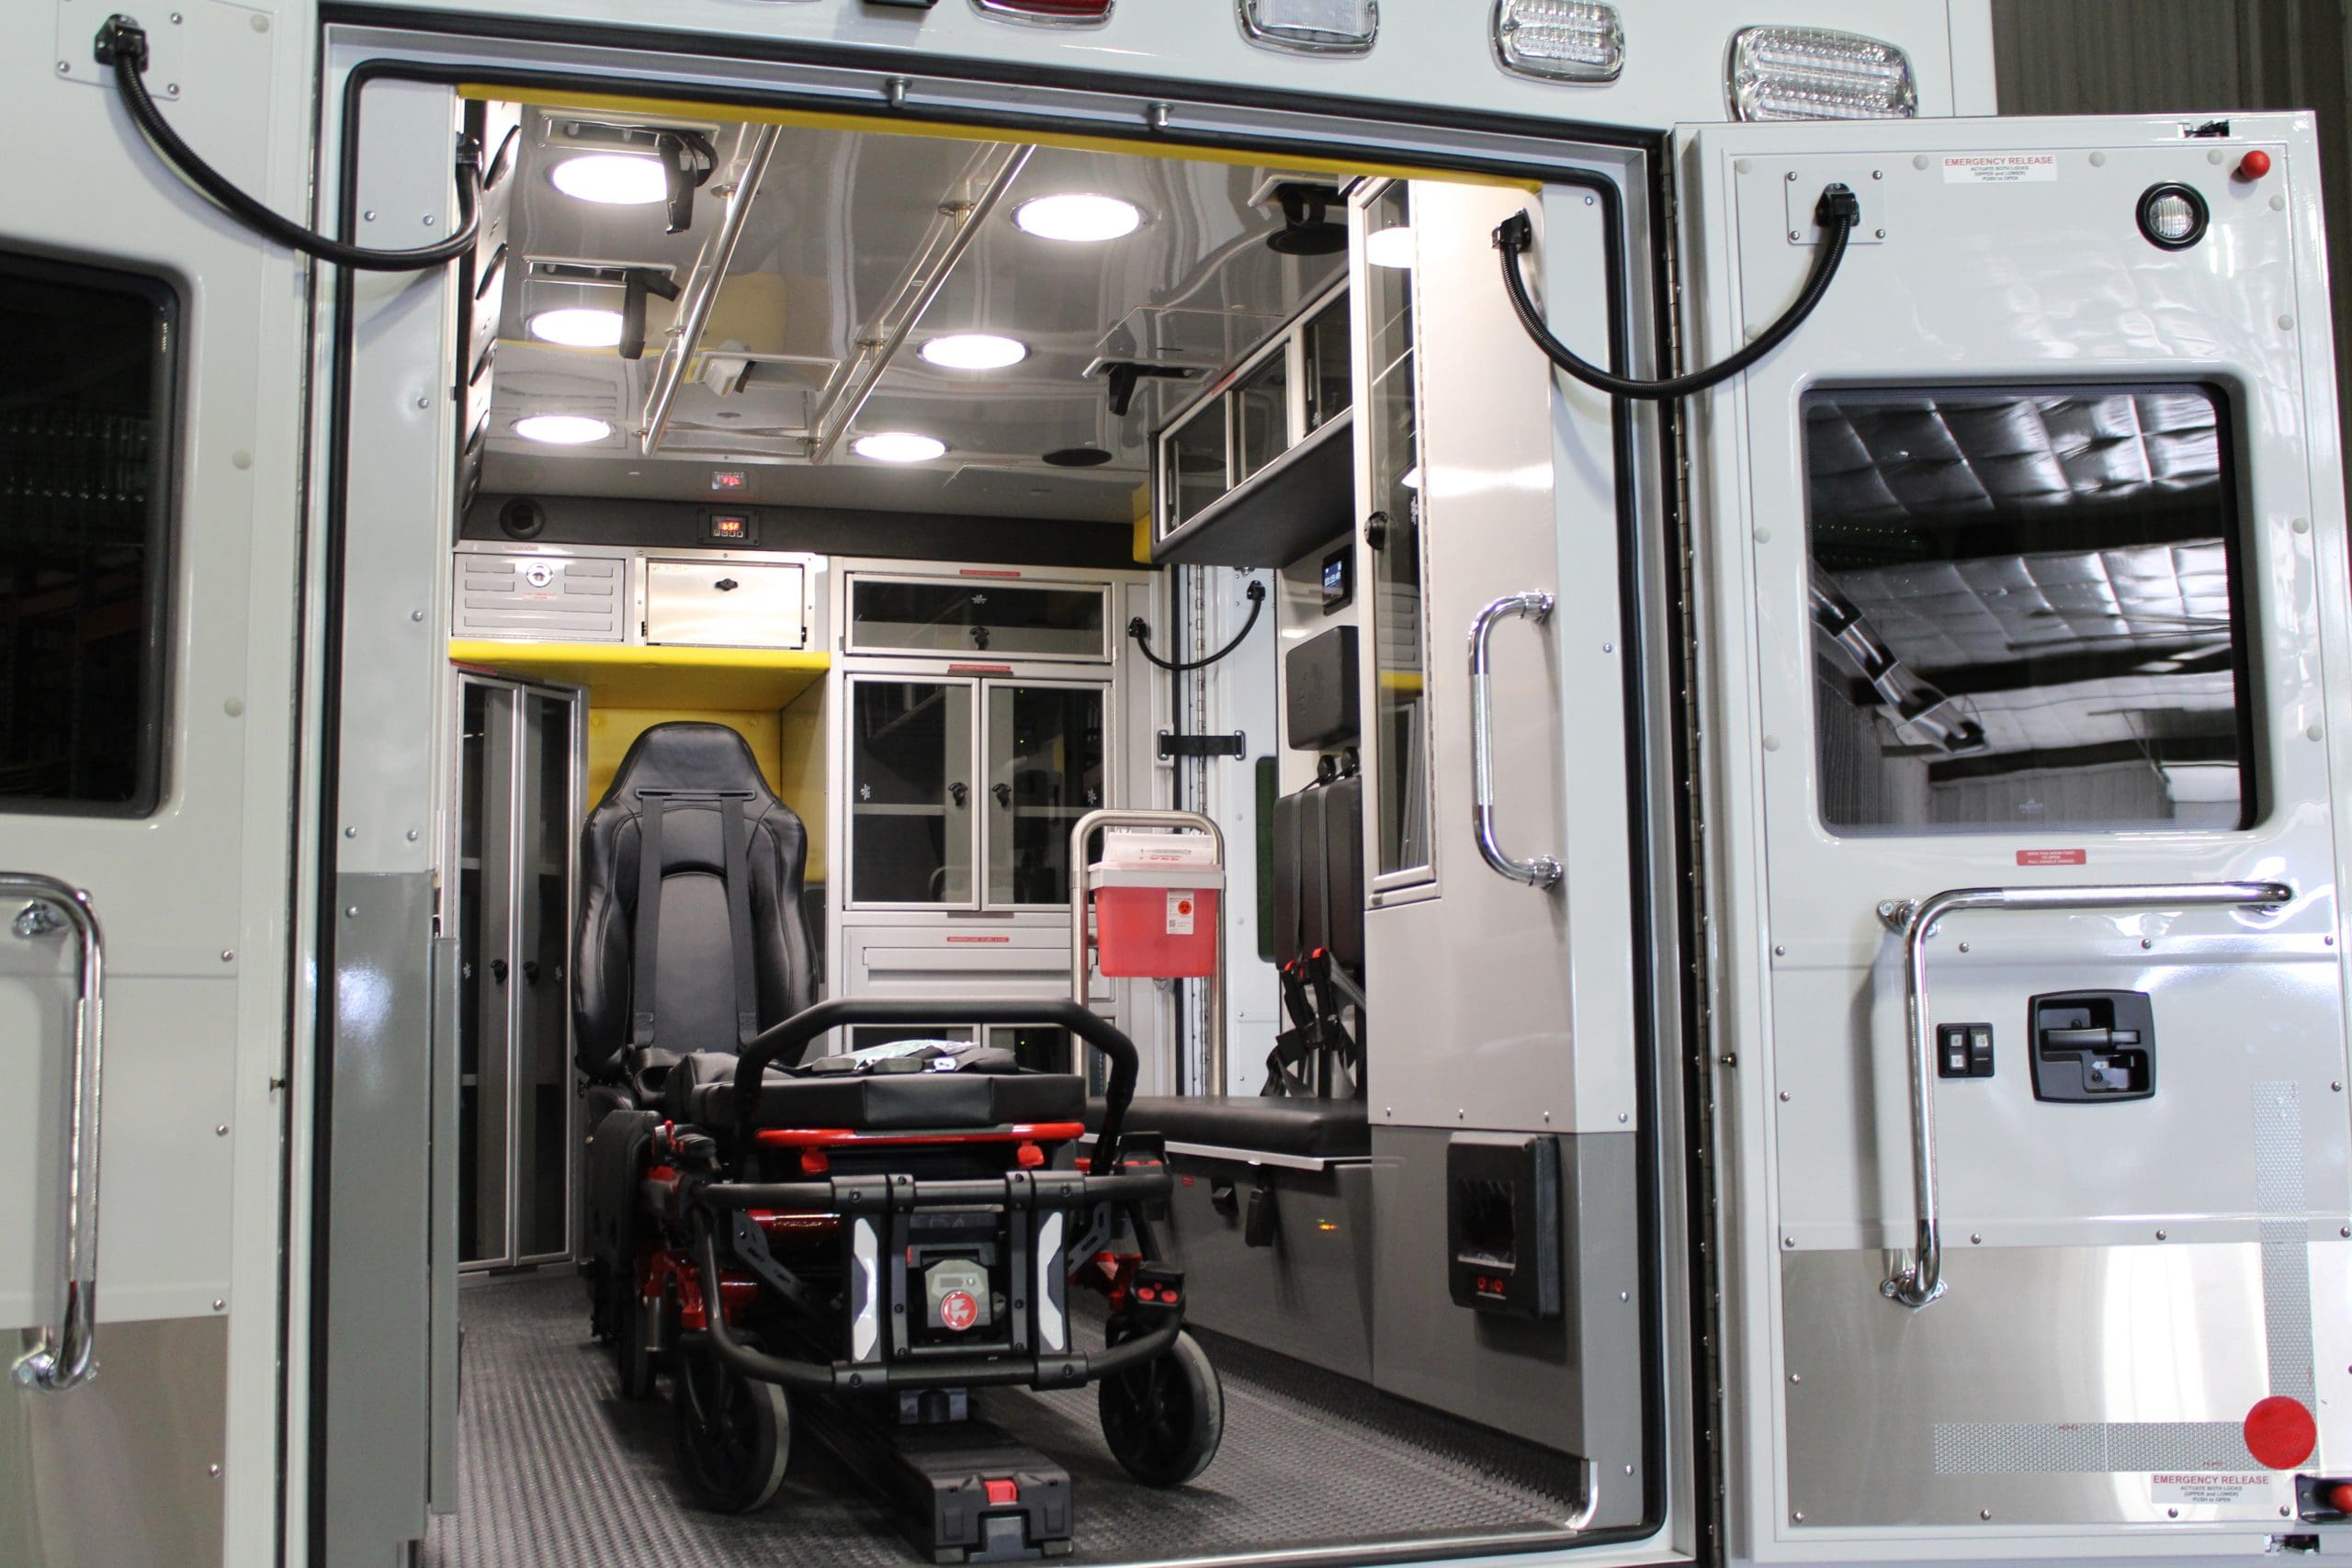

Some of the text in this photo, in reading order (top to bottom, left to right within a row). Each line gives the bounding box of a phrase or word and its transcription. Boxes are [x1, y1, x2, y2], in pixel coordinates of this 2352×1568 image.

[1945, 156, 2053, 166] EMERGENCY RELEASE
[2154, 1475, 2269, 1484] EMERGENCY RELEASE
